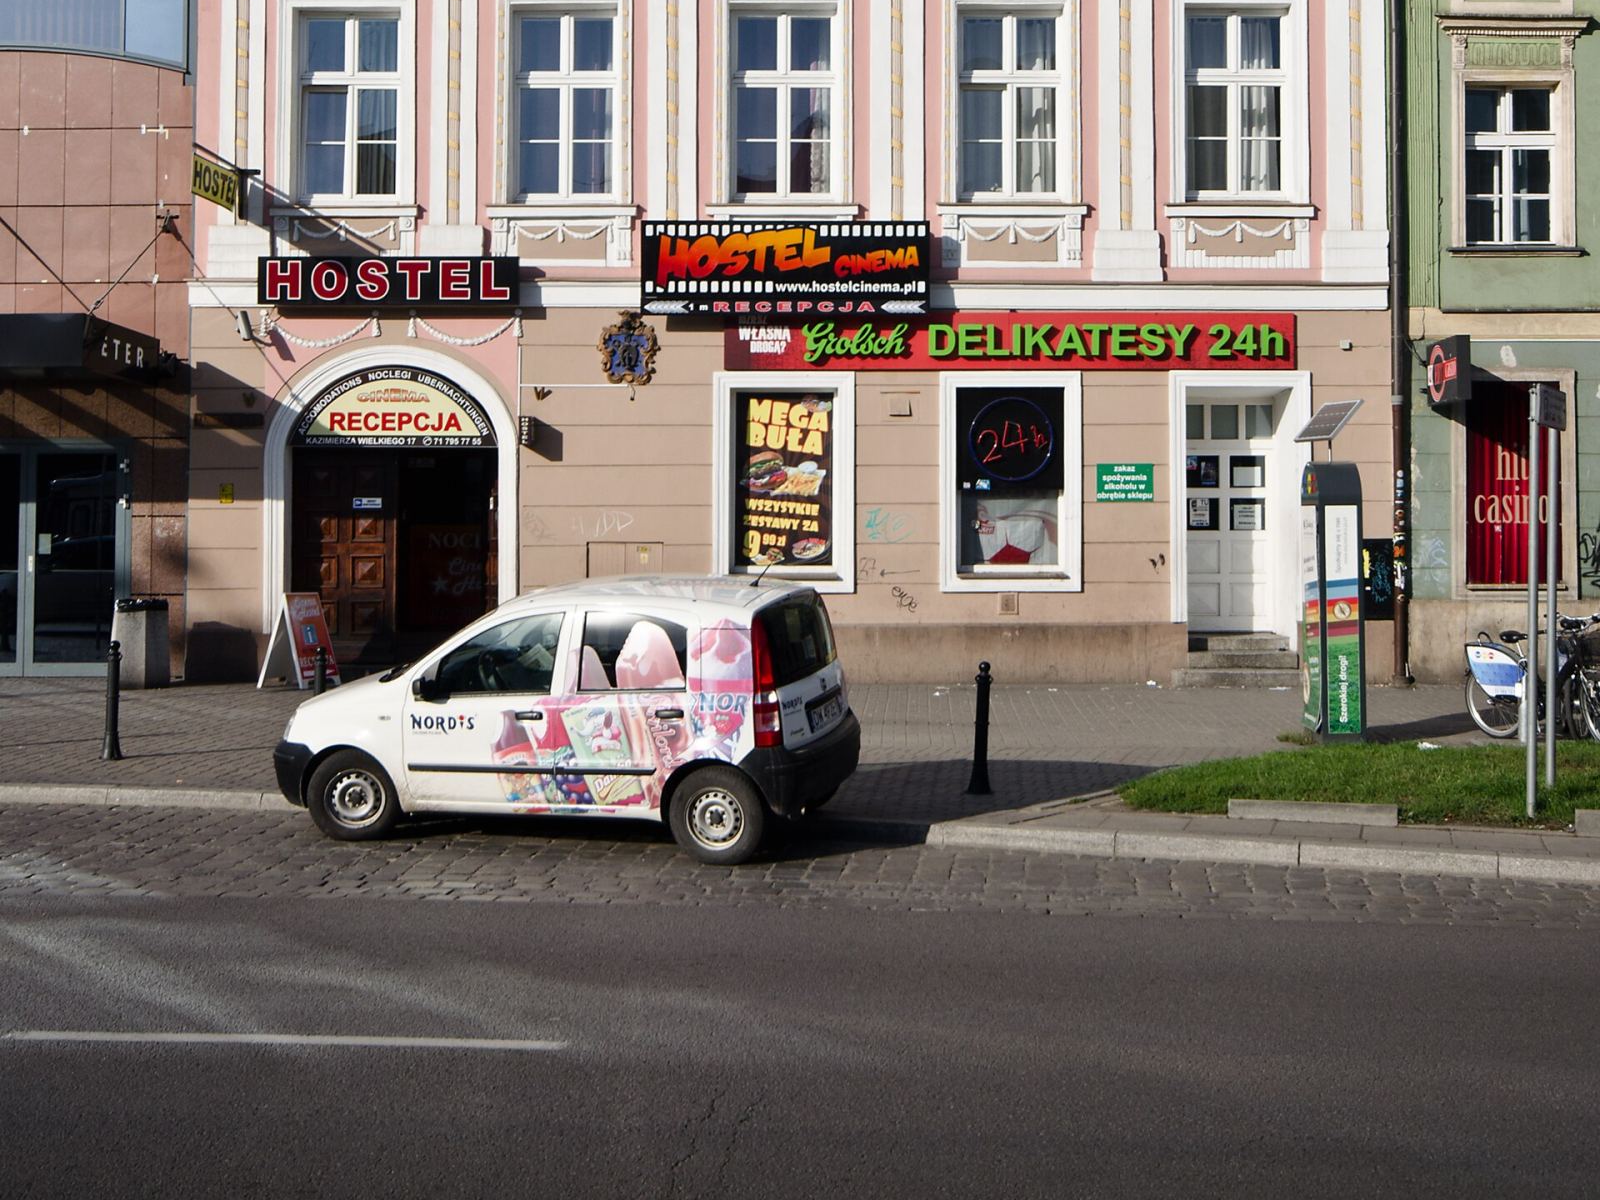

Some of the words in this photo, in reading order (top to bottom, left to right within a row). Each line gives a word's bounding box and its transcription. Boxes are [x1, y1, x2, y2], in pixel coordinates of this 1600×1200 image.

[193, 160, 236, 205] HOSTEL
[657, 227, 831, 288] HOSTEL
[834, 246, 920, 278] CINEMA
[266, 259, 510, 300] HOSTEL
[775, 281, 916, 295] www.hostelcinema.pl
[713, 301, 875, 312] RECEPCJA
[738, 325, 791, 343] WŁASNĄ
[802, 320, 909, 363] Grolsch
[928, 323, 1195, 357] DELIKATESY
[1208, 323, 1285, 357] 24h
[299, 377, 362, 435] ACCOMODATIONS
[367, 370, 411, 381] NOCLEGI
[417, 373, 489, 436] UBERNACHTUNGEN
[357, 388, 430, 403] CINEMA
[329, 412, 462, 432] RECEPCJA
[746, 398, 828, 433] MEGA
[305, 437, 356, 445] KAZIMIERZA
[358, 437, 405, 445] WIELKIEGO
[407, 437, 416, 445] 17
[434, 437, 442, 445] 71
[444, 437, 459, 445] 795
[460, 437, 470, 445] 77
[471, 437, 482, 445] 55
[746, 422, 823, 456] BUŁA
[978, 420, 1048, 464] 24h
[1102, 473, 1148, 482] spożywania
[1104, 482, 1137, 490] alkoholu
[1127, 491, 1153, 500] sklepu
[745, 498, 820, 516] WSZYSTKIE
[743, 514, 800, 531] ZESTAWY
[802, 520, 819, 532] ZA
[1339, 655, 1348, 680] drogi!
[1339, 682, 1348, 723] Szerokiej
